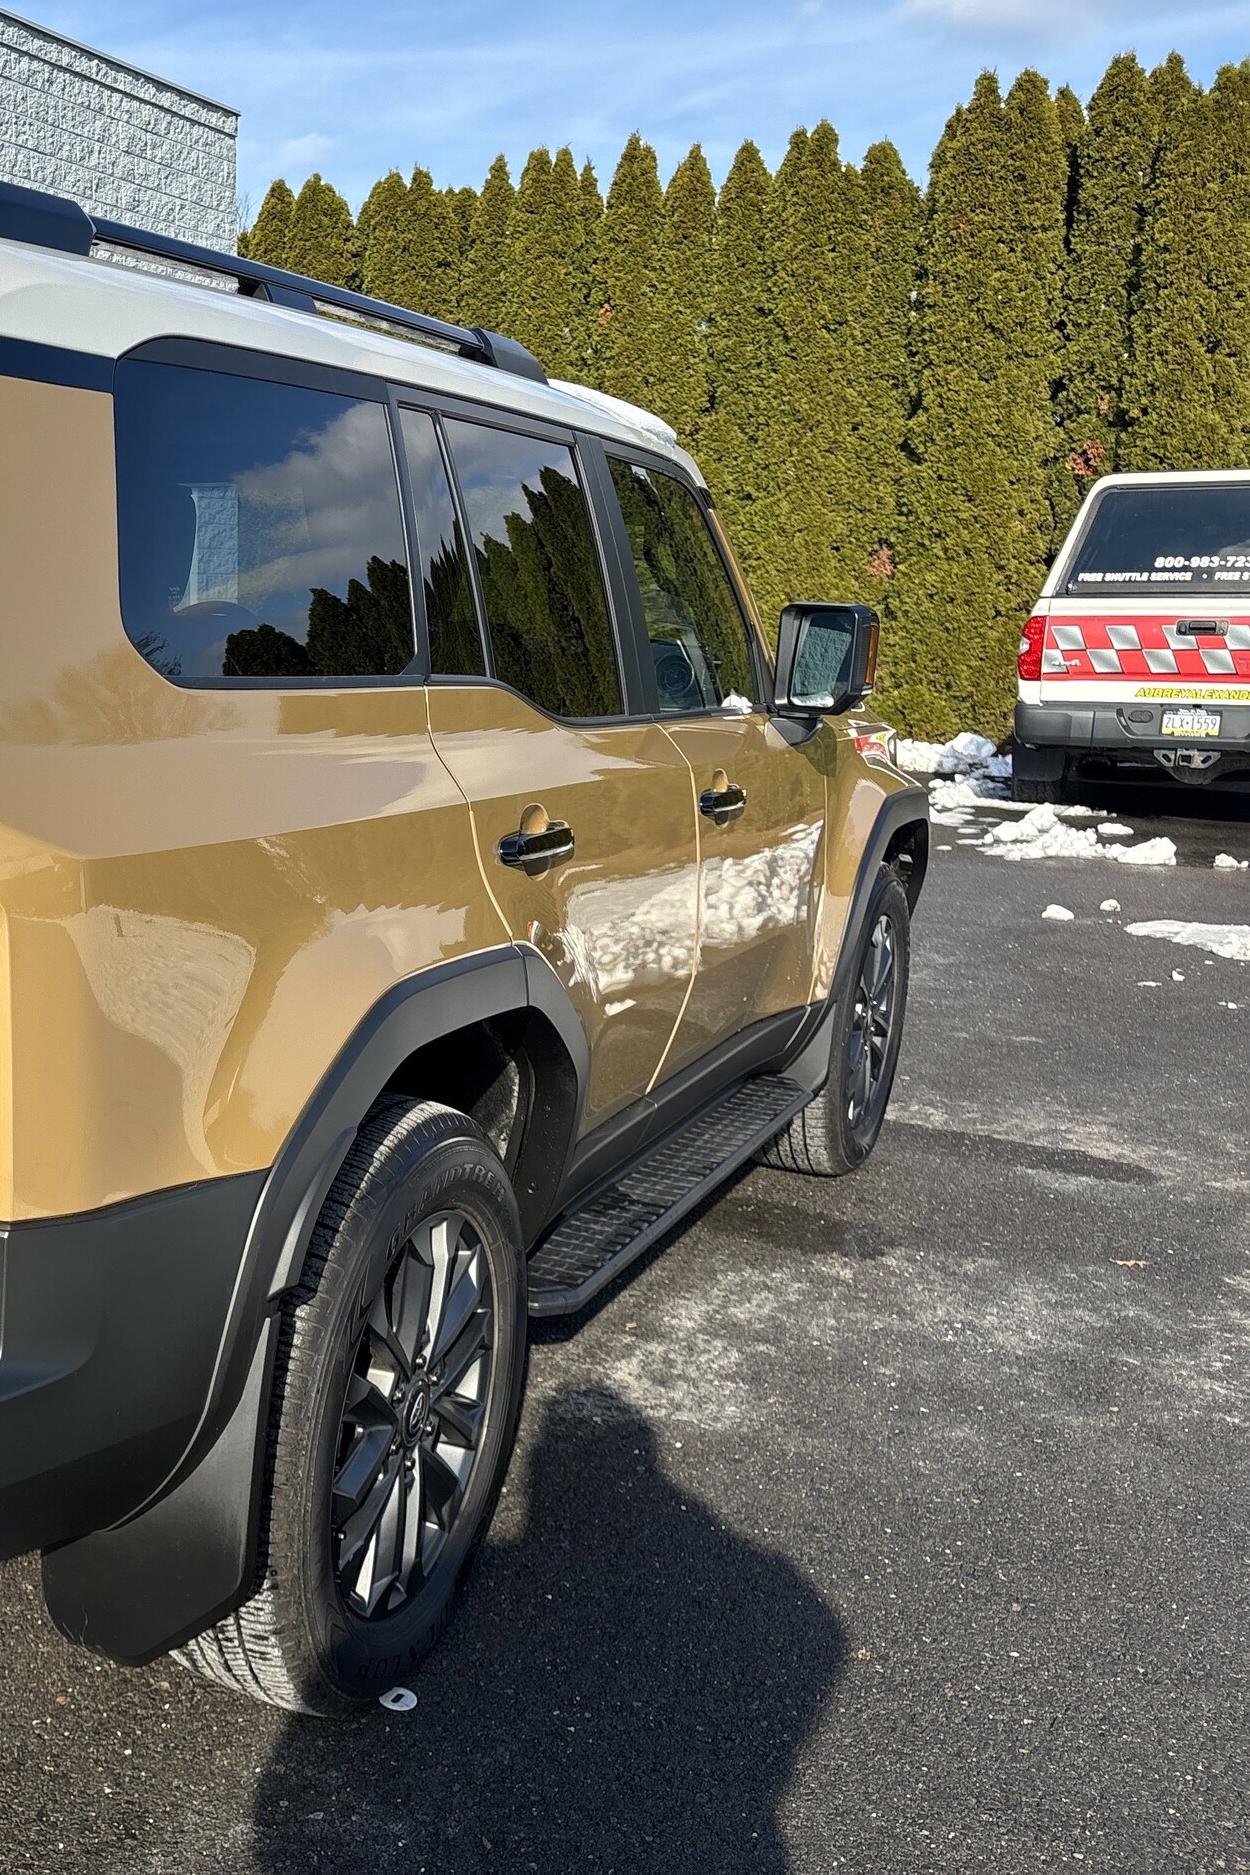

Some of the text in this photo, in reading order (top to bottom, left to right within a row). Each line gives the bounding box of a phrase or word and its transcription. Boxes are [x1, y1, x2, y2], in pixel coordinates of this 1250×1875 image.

[1077, 572, 1104, 581] FREE
[1104, 572, 1149, 581] SHUTTLE
[1150, 572, 1193, 581] SERVICE
[1214, 571, 1241, 580] FREE
[1135, 688, 1250, 700] AUBREYALEXAND
